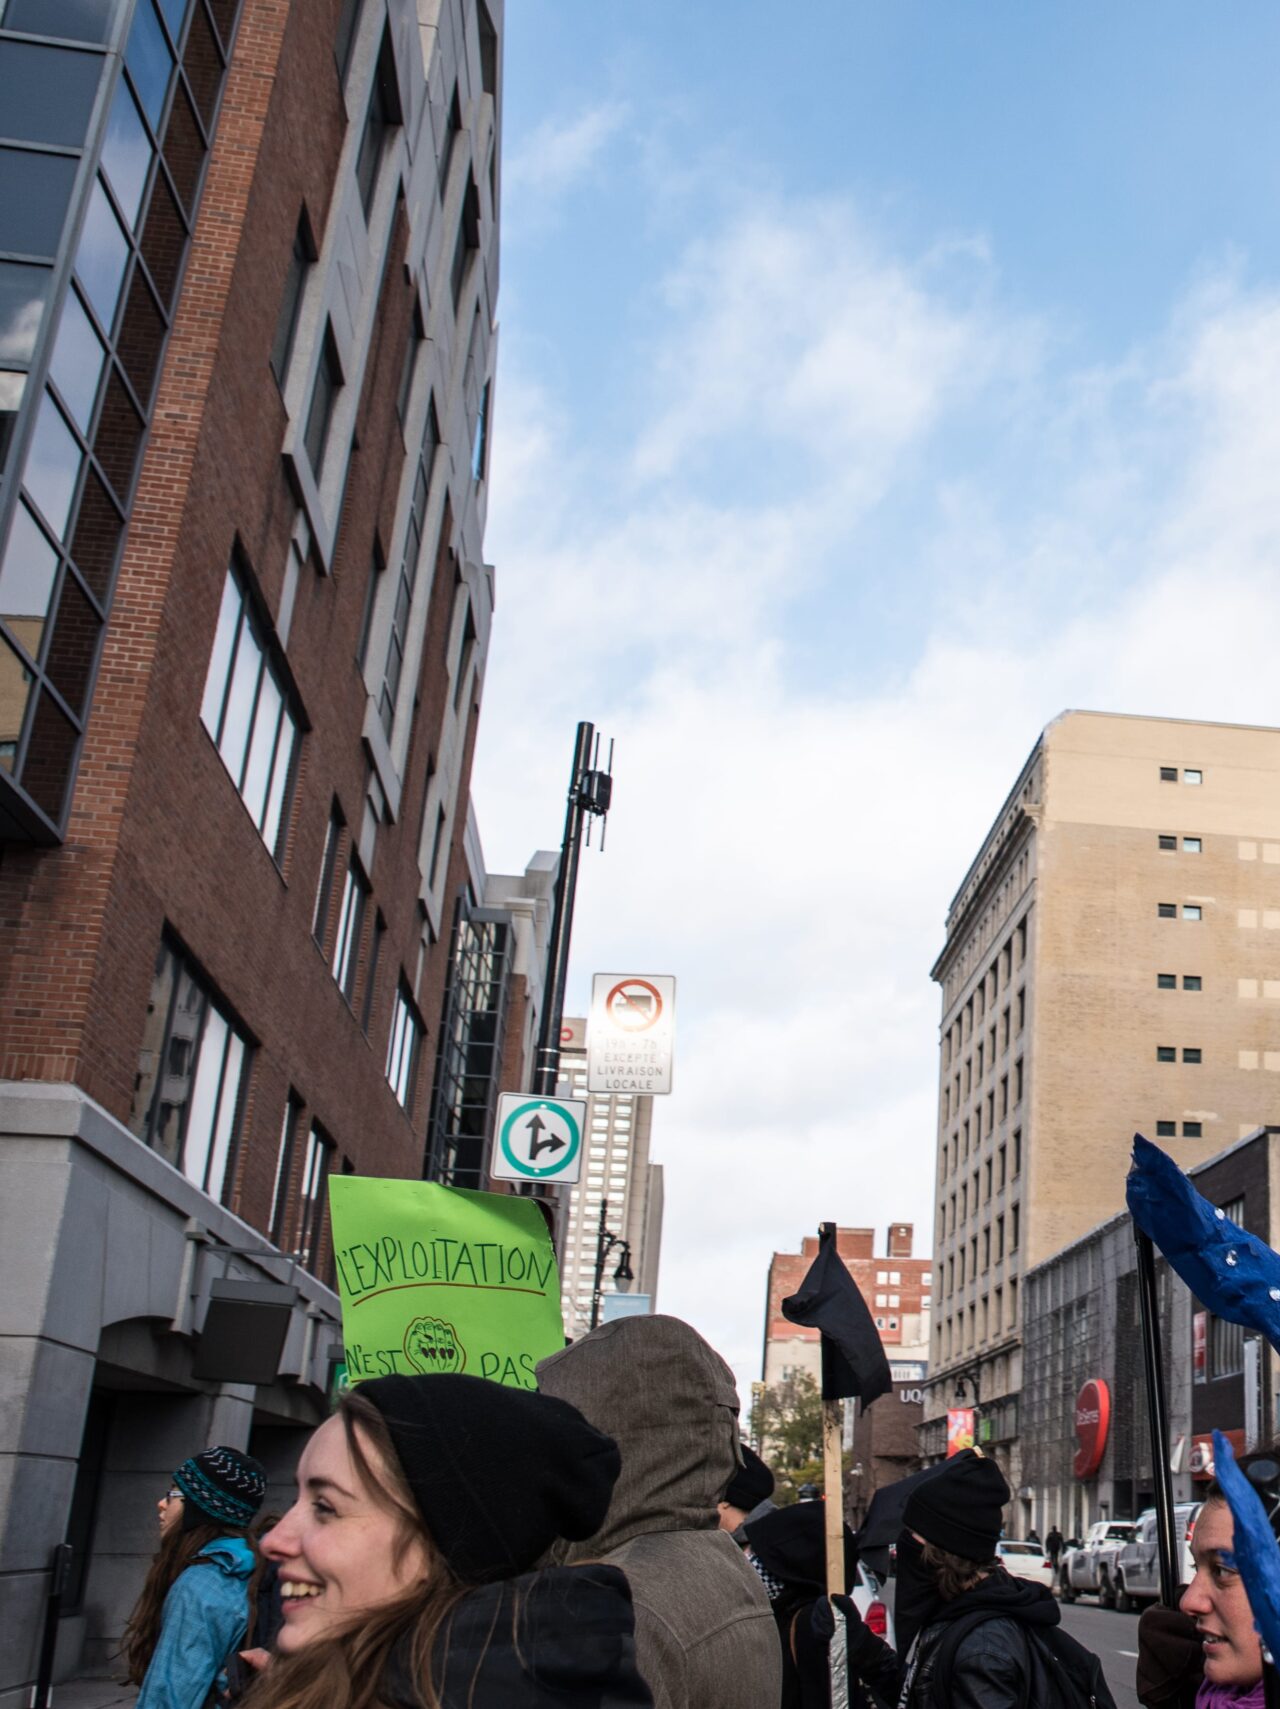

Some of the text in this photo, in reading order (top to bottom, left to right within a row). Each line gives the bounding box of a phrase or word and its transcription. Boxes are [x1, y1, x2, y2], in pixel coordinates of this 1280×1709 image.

[597, 1066, 663, 1077] LIVRAISON
[605, 1079, 653, 1090] LOCALE
[336, 1236, 553, 1297] L'EXPLOITATION
[345, 1344, 539, 1391] N'EST PAS
[900, 1389, 924, 1404] UQ
